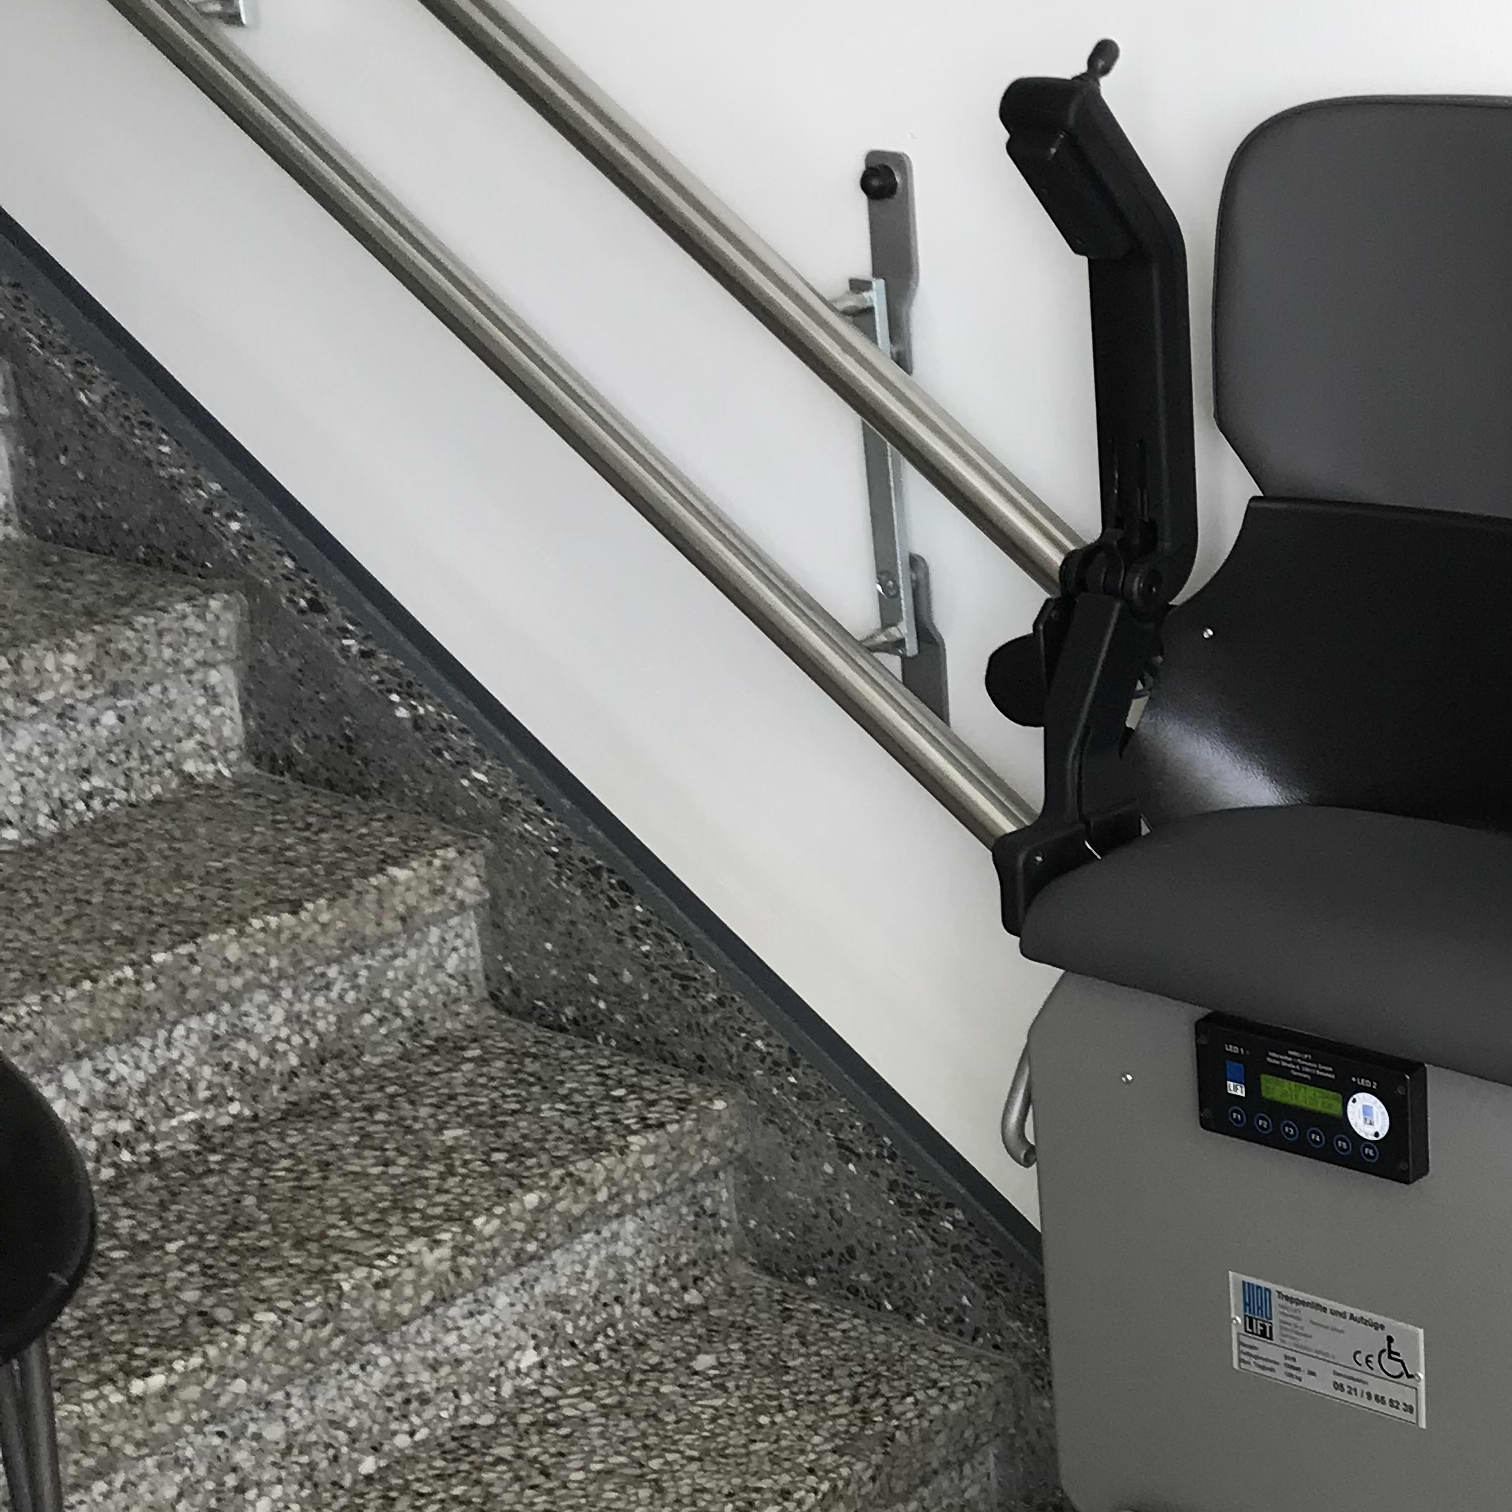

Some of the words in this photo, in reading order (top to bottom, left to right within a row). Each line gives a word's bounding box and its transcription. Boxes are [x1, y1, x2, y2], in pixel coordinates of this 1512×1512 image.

[1225, 1044, 1239, 1054] LED
[1357, 1077, 1371, 1087] LED
[1330, 1308, 1347, 1320] und
[1245, 1315, 1272, 1340] LIFT
[1353, 1350, 1374, 1371] CE
